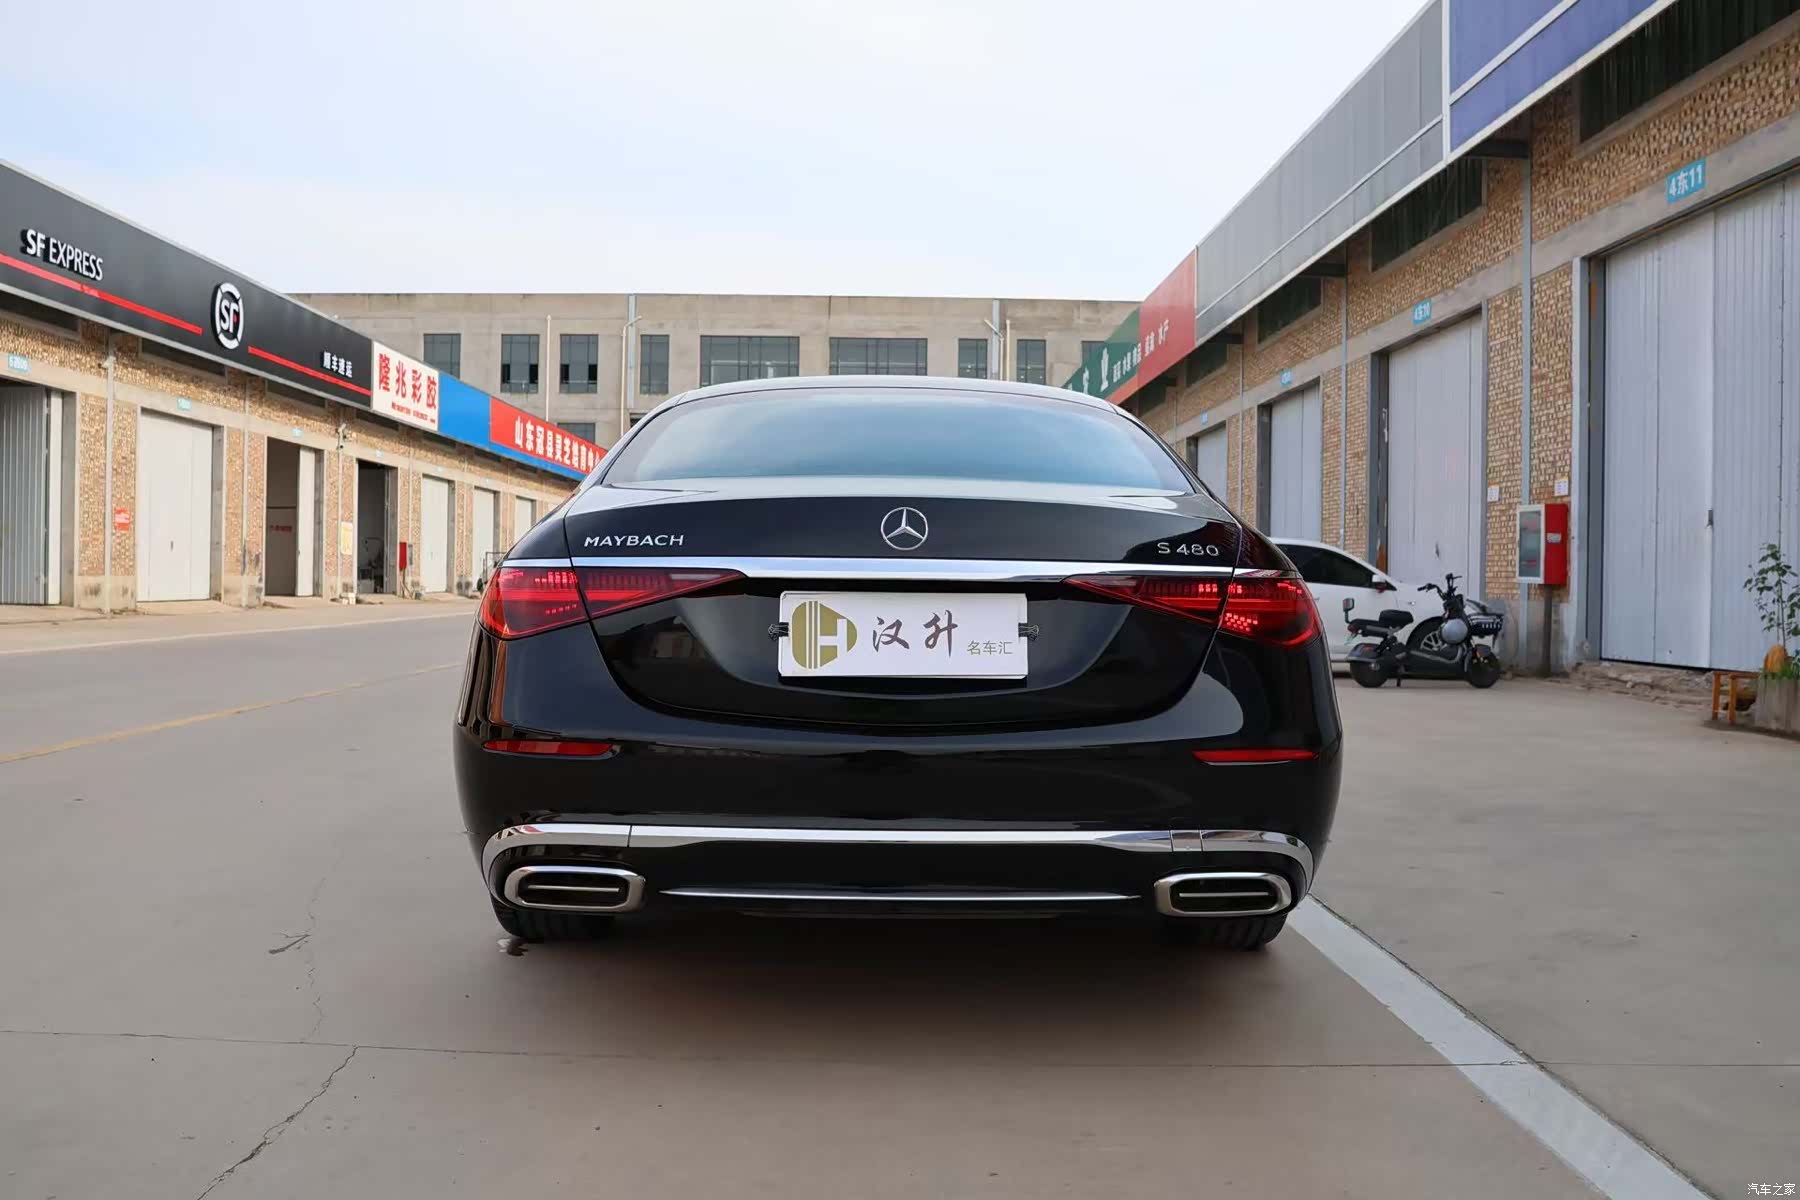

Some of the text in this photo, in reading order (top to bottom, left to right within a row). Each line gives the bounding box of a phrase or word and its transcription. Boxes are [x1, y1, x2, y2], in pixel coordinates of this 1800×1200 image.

[1668, 164, 1703, 197] 4东11
[25, 227, 104, 282] SF EXPRESS
[322, 351, 354, 380] 顺丰速运
[583, 534, 685, 548] MAYBACH
[1157, 542, 1220, 557] S 480
[872, 608, 959, 658] 汉升
[966, 639, 1013, 656] 名车汇
